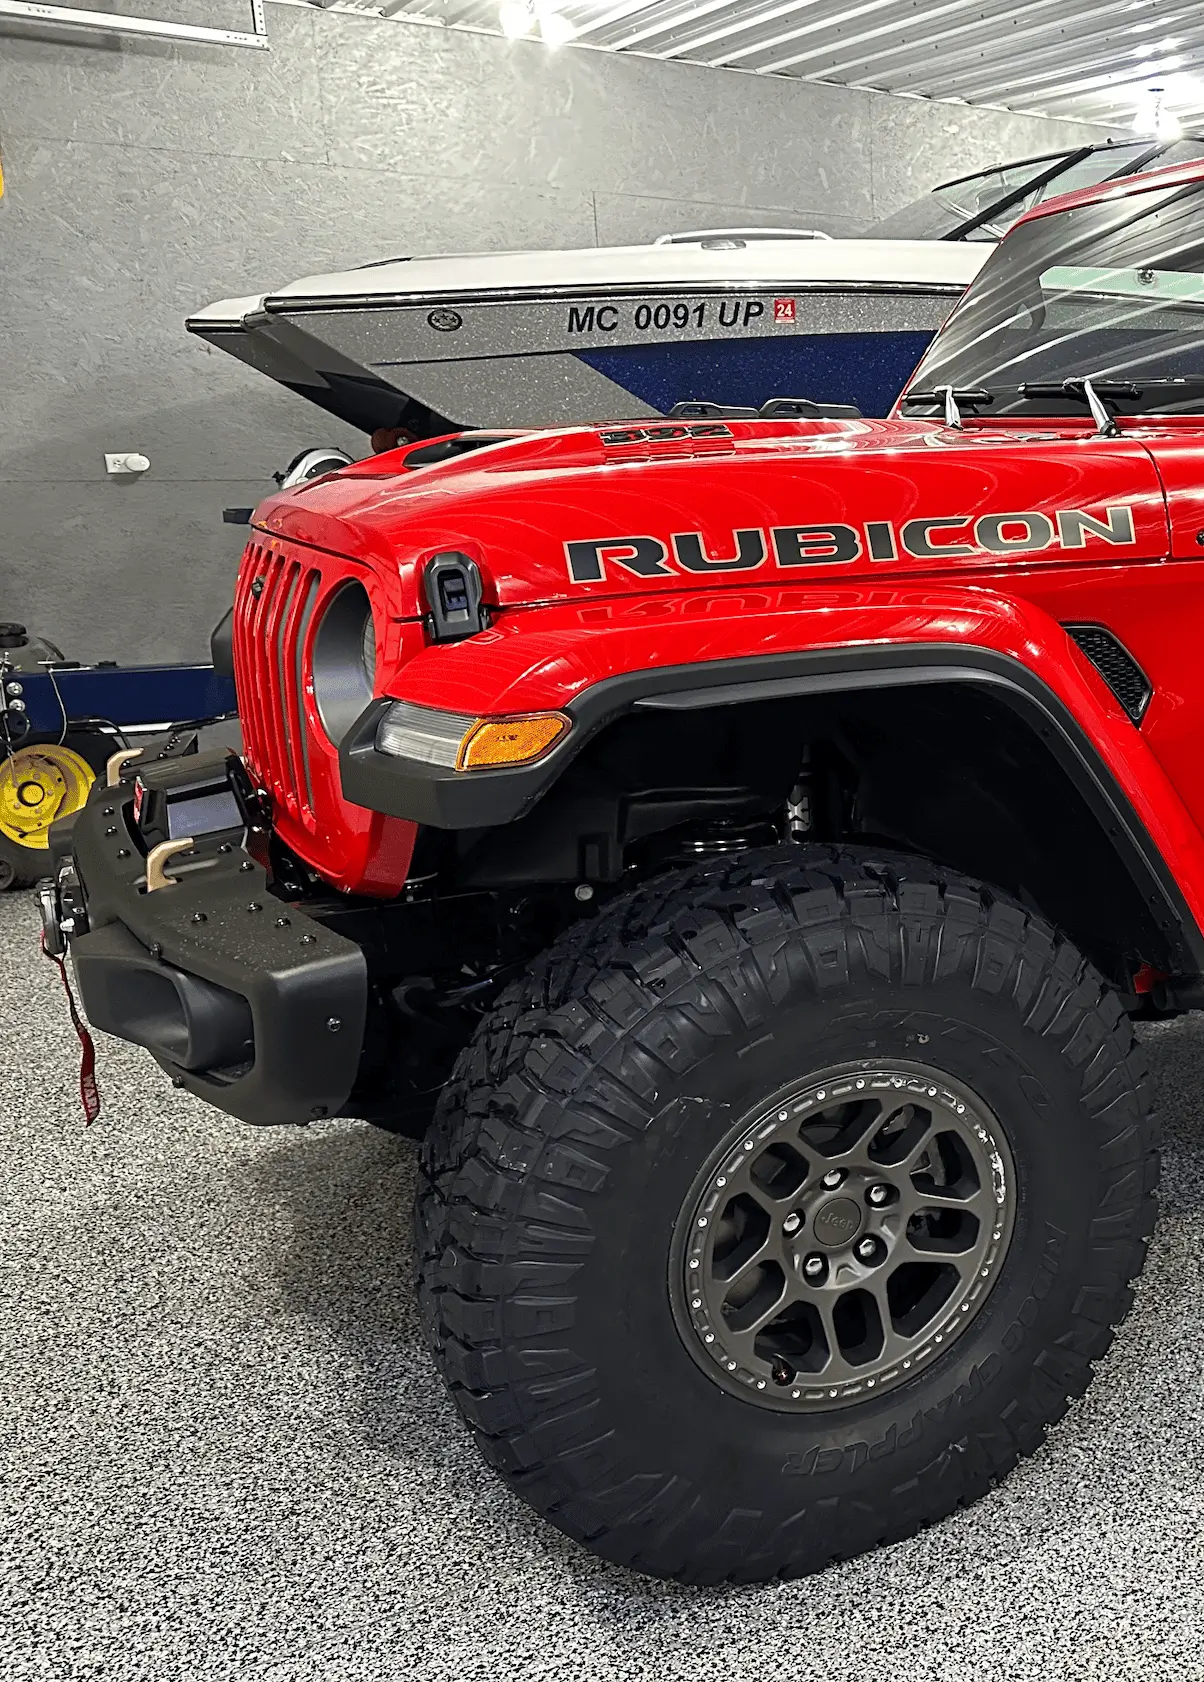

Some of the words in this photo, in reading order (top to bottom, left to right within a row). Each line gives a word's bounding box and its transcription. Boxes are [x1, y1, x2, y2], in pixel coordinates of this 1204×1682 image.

[567, 306, 619, 332] MC
[634, 302, 706, 330] 0091
[718, 301, 764, 328] UP
[777, 303, 792, 317] 24
[562, 505, 1137, 585] RUBICON
[780, 1351, 1004, 1477] GRAPPLER
